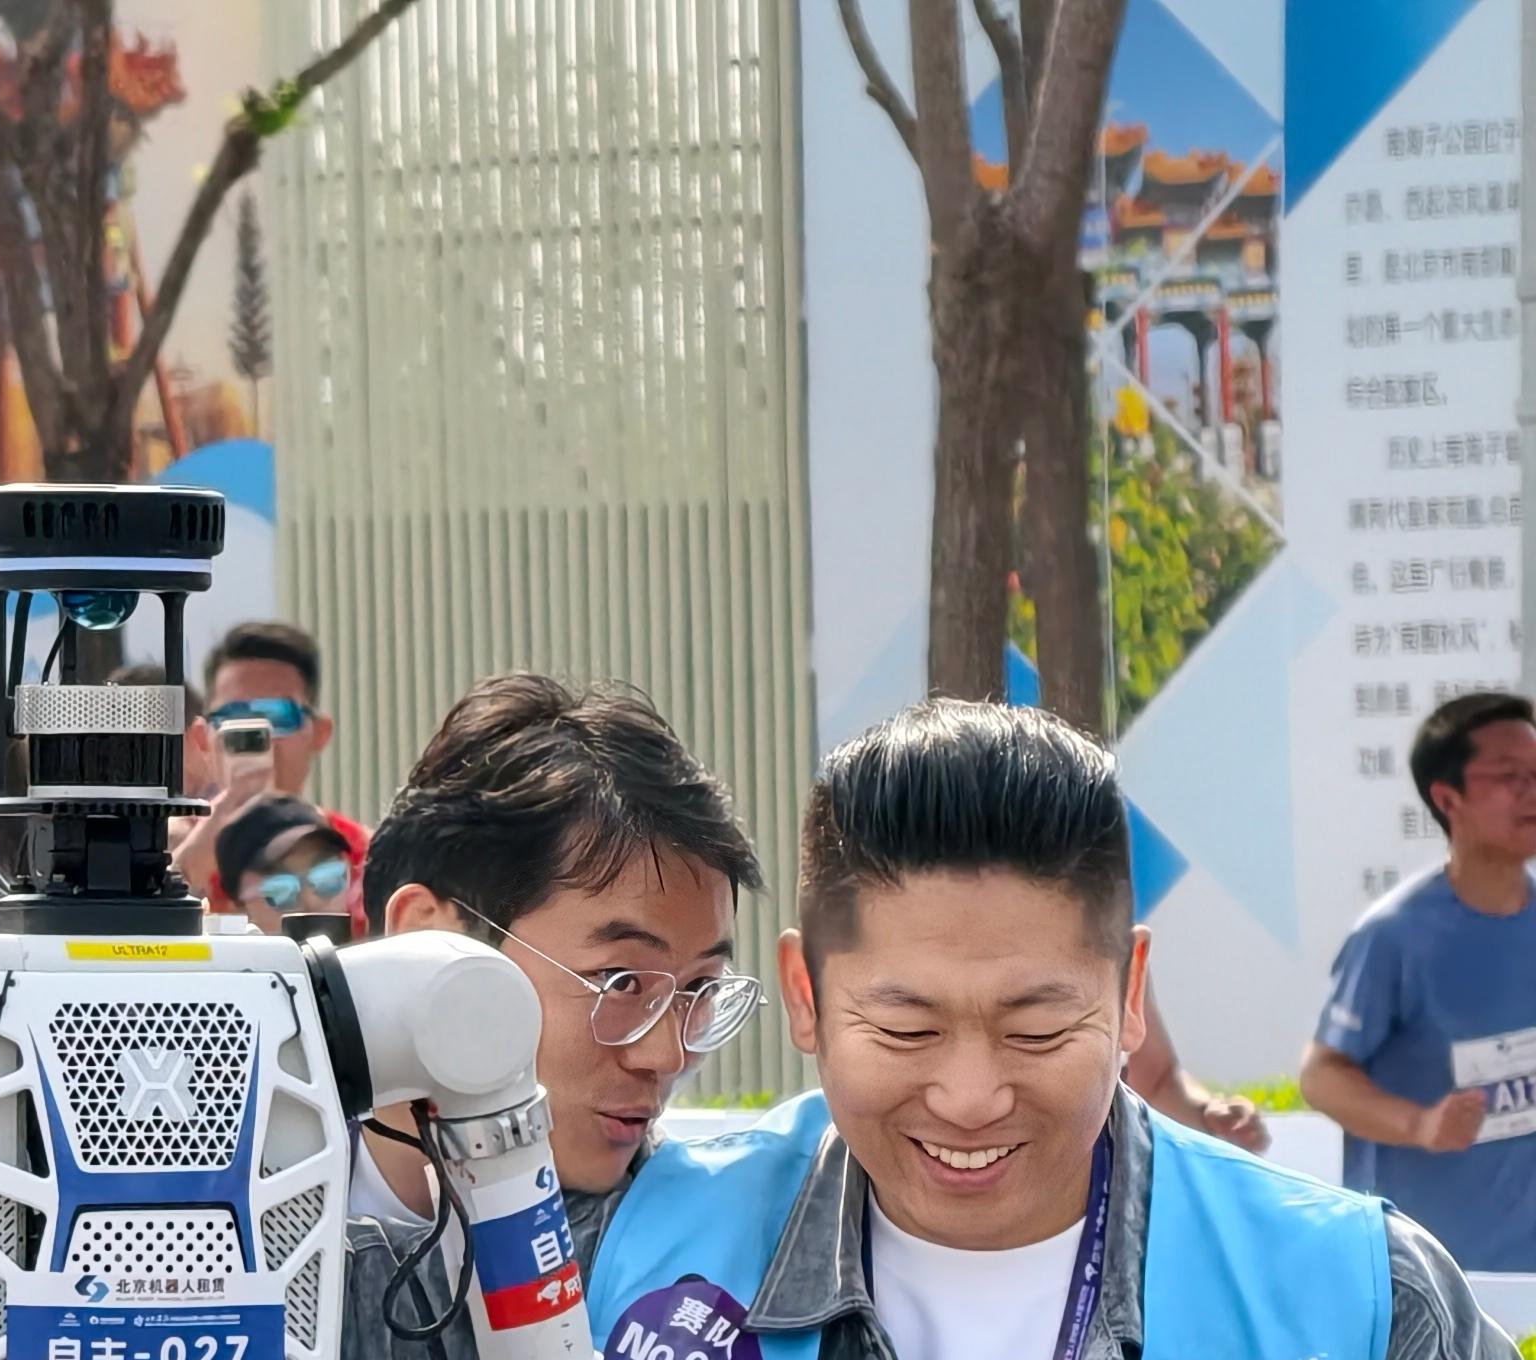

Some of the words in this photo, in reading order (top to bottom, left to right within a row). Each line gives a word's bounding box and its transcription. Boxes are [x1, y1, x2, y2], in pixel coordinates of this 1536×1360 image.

[115, 1277, 225, 1295] 北京机器人租赁
[669, 1296, 741, 1360] 赛队
